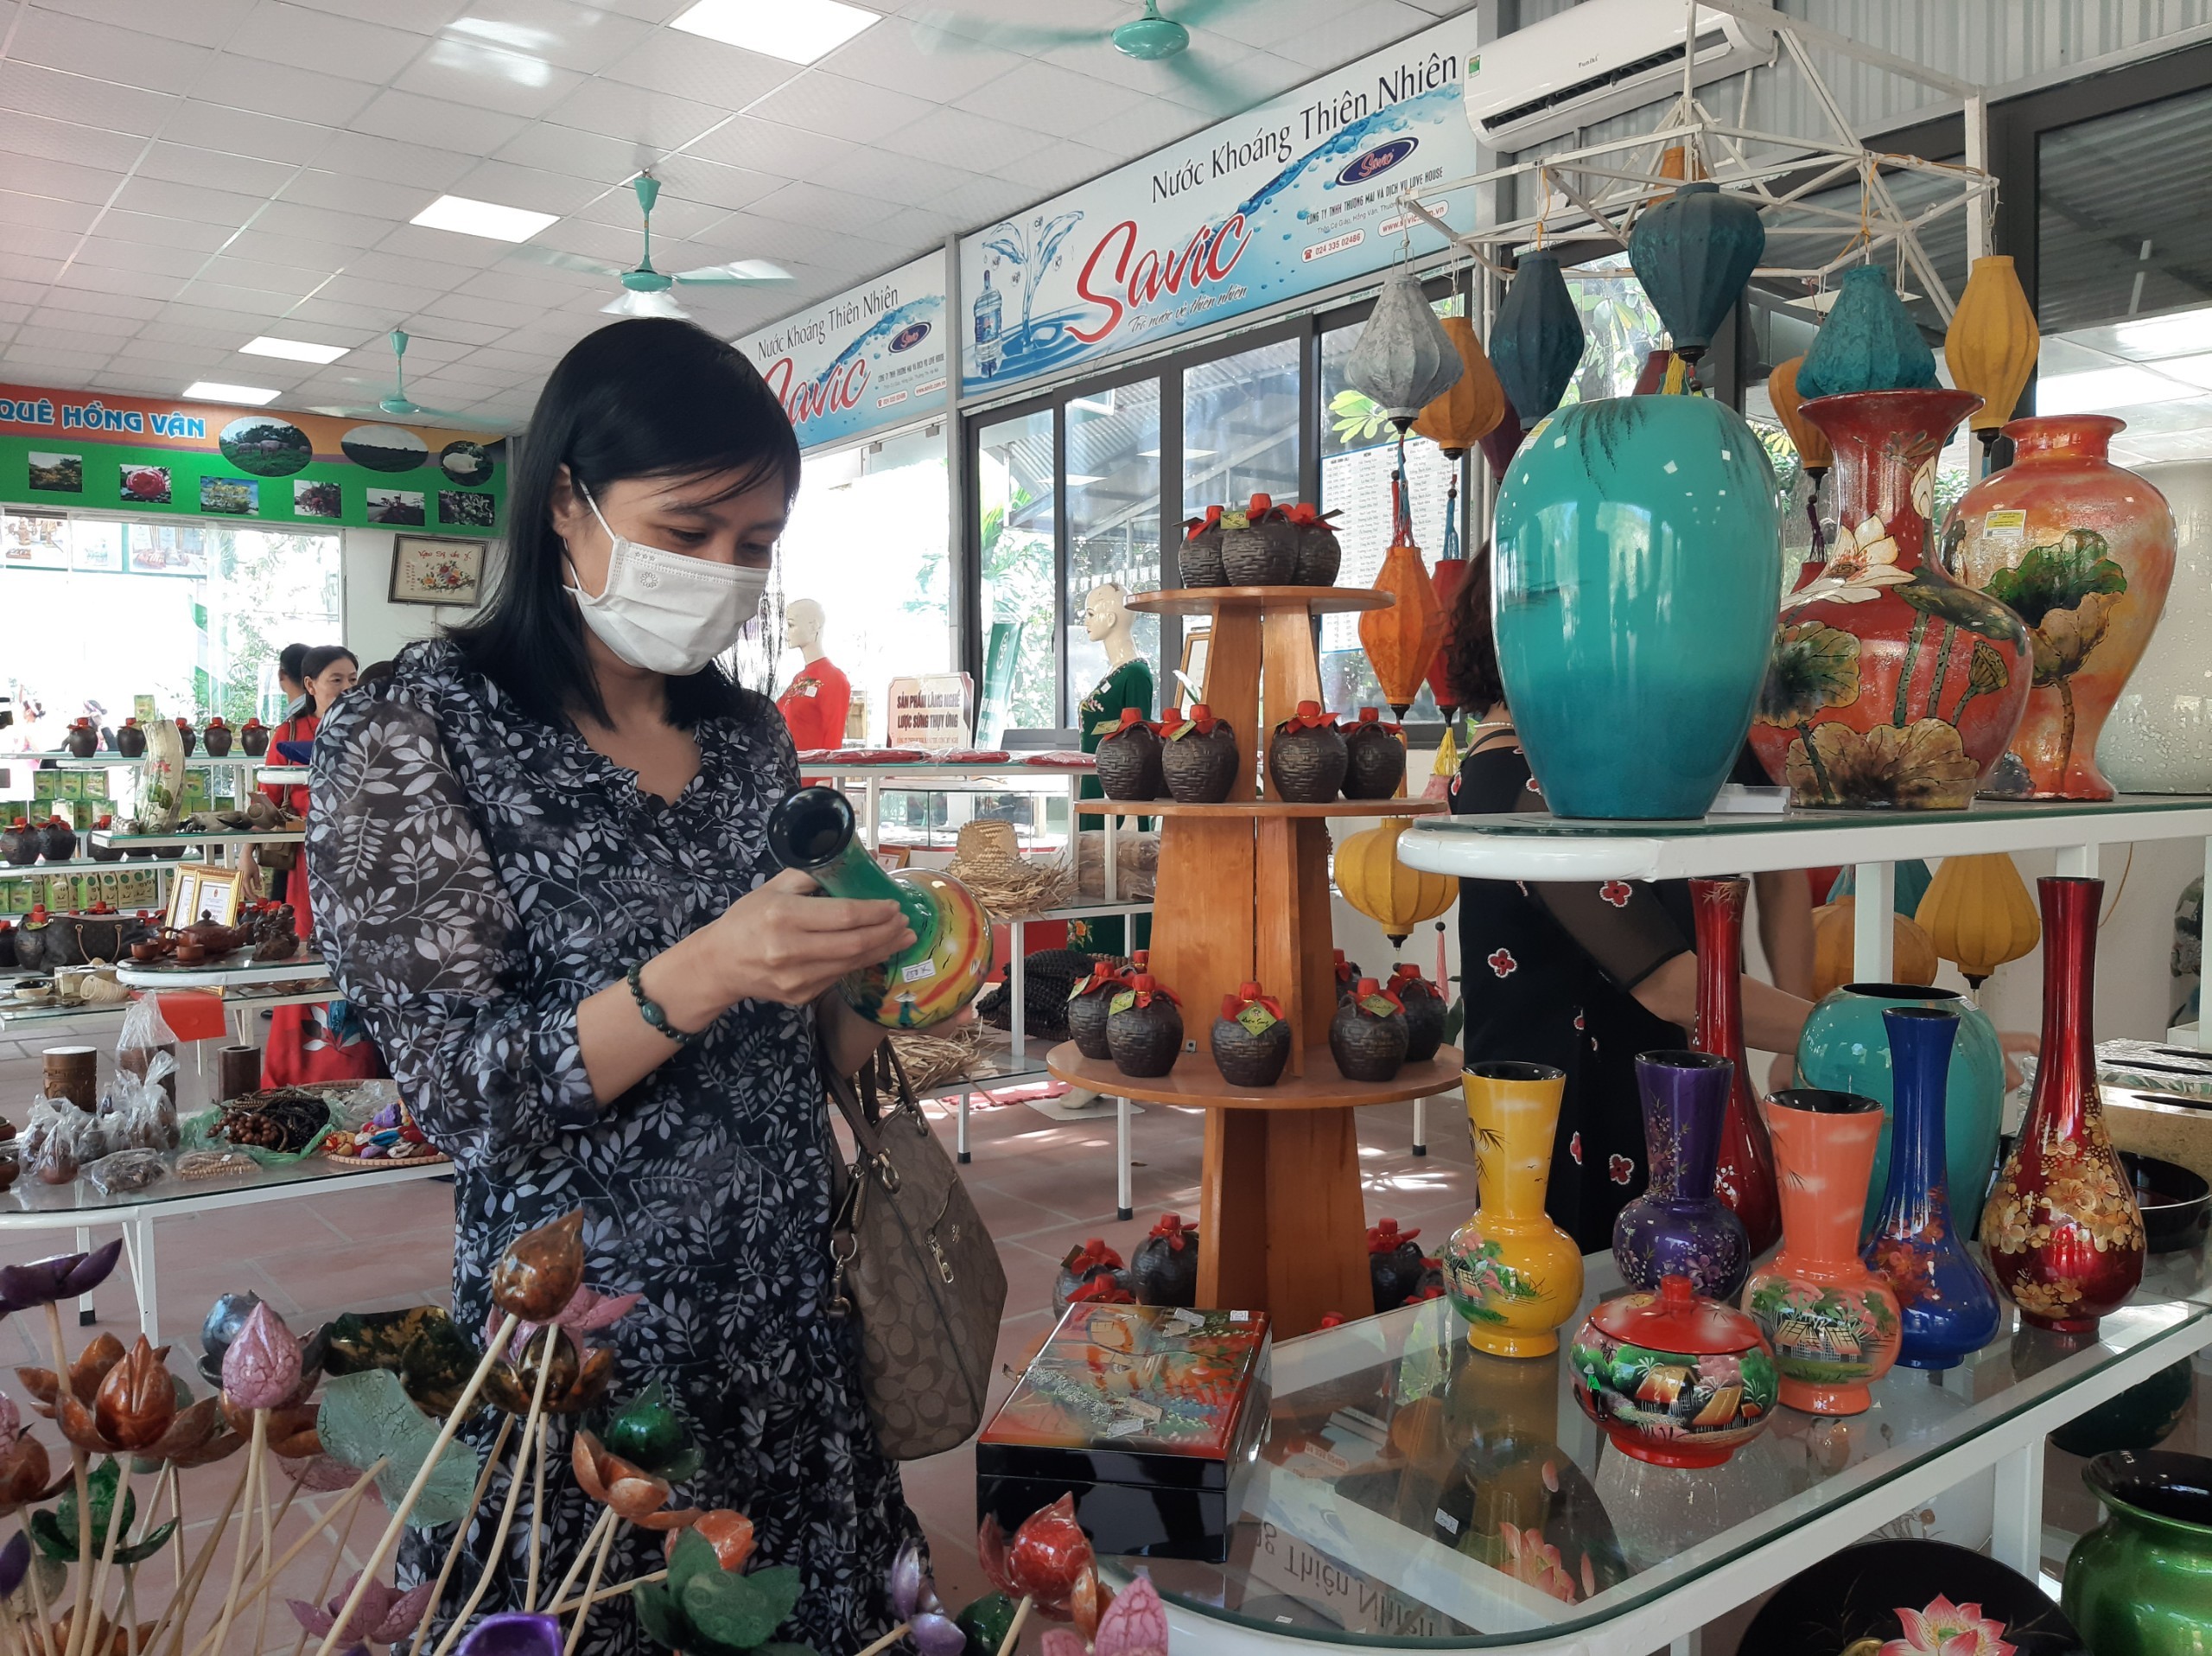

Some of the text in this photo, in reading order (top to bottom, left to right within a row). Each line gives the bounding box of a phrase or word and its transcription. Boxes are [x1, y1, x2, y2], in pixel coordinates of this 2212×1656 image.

[1152, 158, 1205, 204] Nước
[1211, 124, 1293, 179] Khoáng
[1300, 90, 1368, 141] Thiên
[1376, 52, 1457, 111] Nhiên
[1410, 174, 1422, 188] LOVE
[1425, 167, 1443, 182] HOUSE
[1315, 245, 1326, 255] 024
[1328, 240, 1339, 252] 335
[1064, 213, 1253, 343] Savic
[759, 285, 899, 361] Nước Khoáng Thiên Nhiên
[0, 398, 206, 439] QUÊ HỒNG VÂN
[897, 691, 909, 709] SẢN
[910, 690, 926, 708] PHẨM
[928, 691, 943, 708] LÀNG
[898, 714, 912, 730] LƯỢC
[930, 714, 944, 730] THỤY
